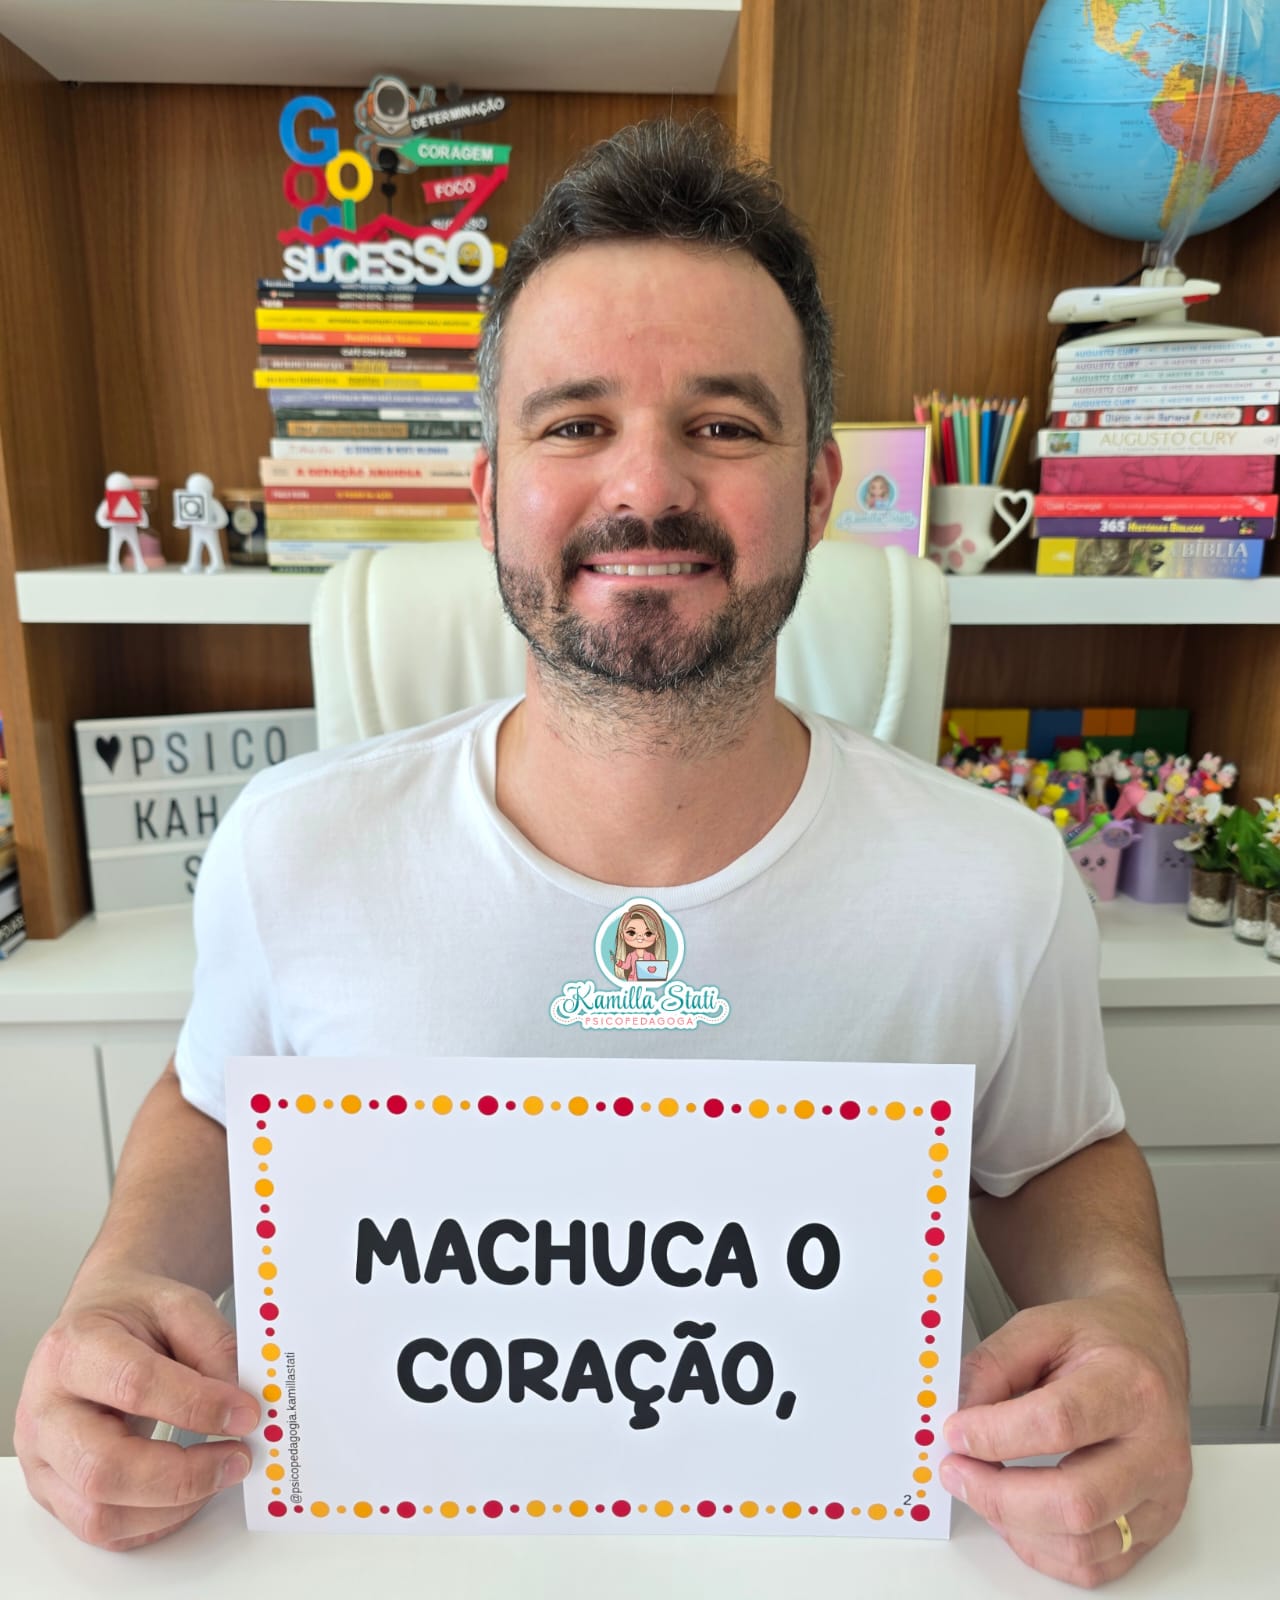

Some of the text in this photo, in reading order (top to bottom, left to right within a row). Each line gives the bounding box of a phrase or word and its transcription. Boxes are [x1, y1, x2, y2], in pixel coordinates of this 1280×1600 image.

[411, 96, 505, 130] DETERMINAÇÃO
[417, 143, 494, 162] CORAGEM
[434, 178, 476, 199] FOCO
[282, 230, 495, 287] SUCESSO
[1075, 348, 1114, 358] AUGUSTO
[1117, 347, 1139, 356] CURY
[1076, 361, 1114, 370] AUGUSTO
[1117, 360, 1139, 369] CURY
[1071, 374, 1111, 383] AUGUSTO
[1112, 373, 1135, 382] CURY
[1075, 386, 1114, 395] AUGUSTO
[1115, 384, 1138, 393] CURY
[1072, 399, 1112, 408] AUGUSTO
[1114, 398, 1136, 407] CURY
[1100, 431, 1238, 448] AUGUSTO CURY
[1100, 519, 1126, 533] 365
[1182, 540, 1248, 558] BÍBLIA
[131, 725, 287, 777] PSICO
[355, 1217, 841, 1290] MACHUCA O
[397, 1320, 797, 1430] CORAÇÃO,
[284, 1351, 303, 1504] @psicopedagogia.kamillastati
[903, 1494, 912, 1506] 2
